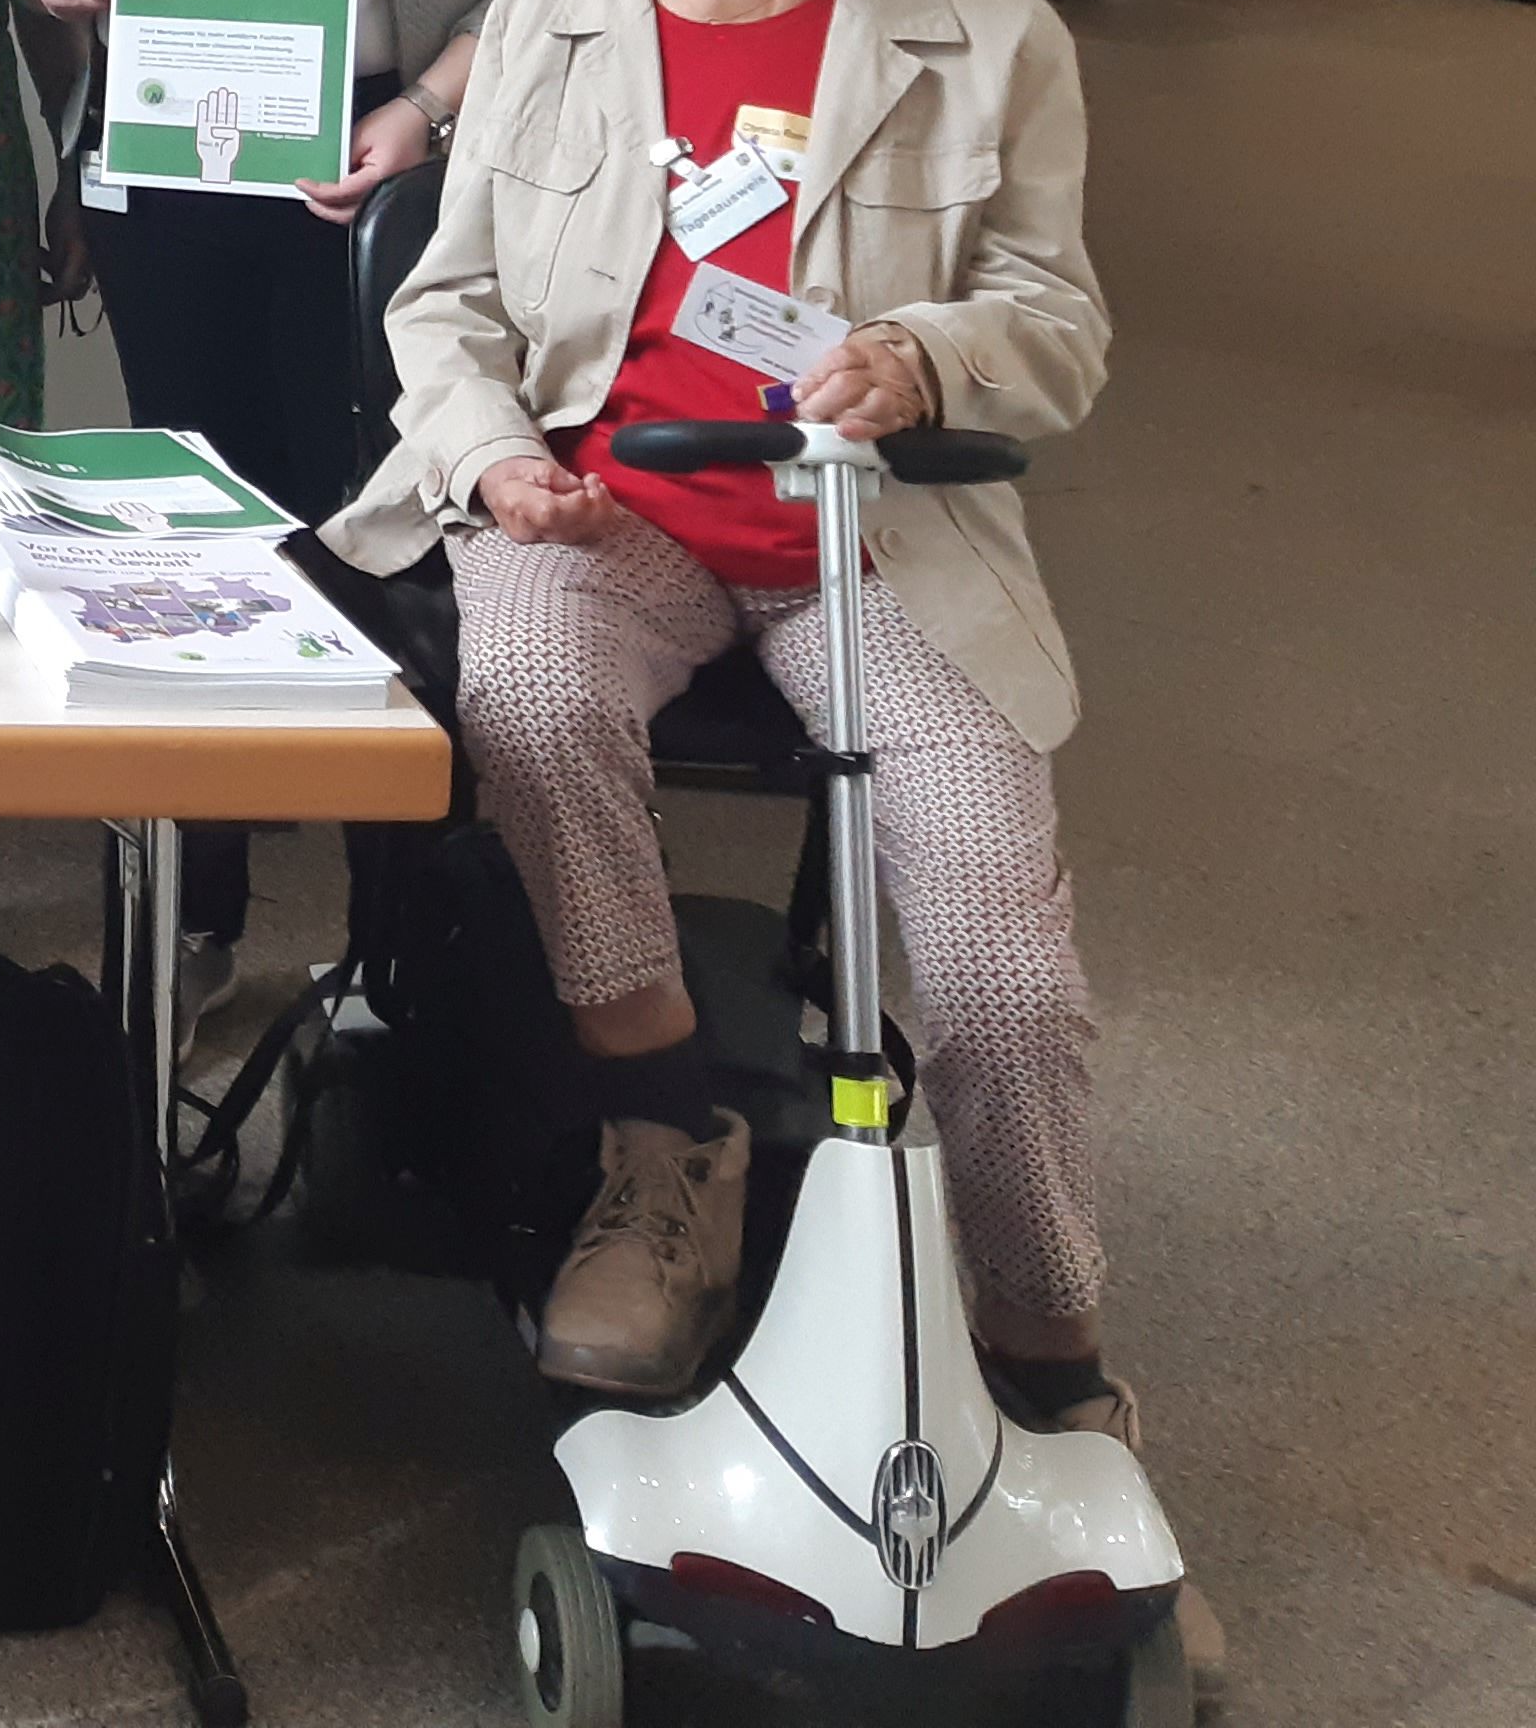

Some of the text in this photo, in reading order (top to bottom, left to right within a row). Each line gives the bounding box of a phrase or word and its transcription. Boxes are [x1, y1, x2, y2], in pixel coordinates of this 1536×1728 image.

[680, 175, 767, 235] Tagesausweis
[18, 540, 202, 559] Vor Ort inklusiv
[30, 552, 194, 568] gegen Gewalt
